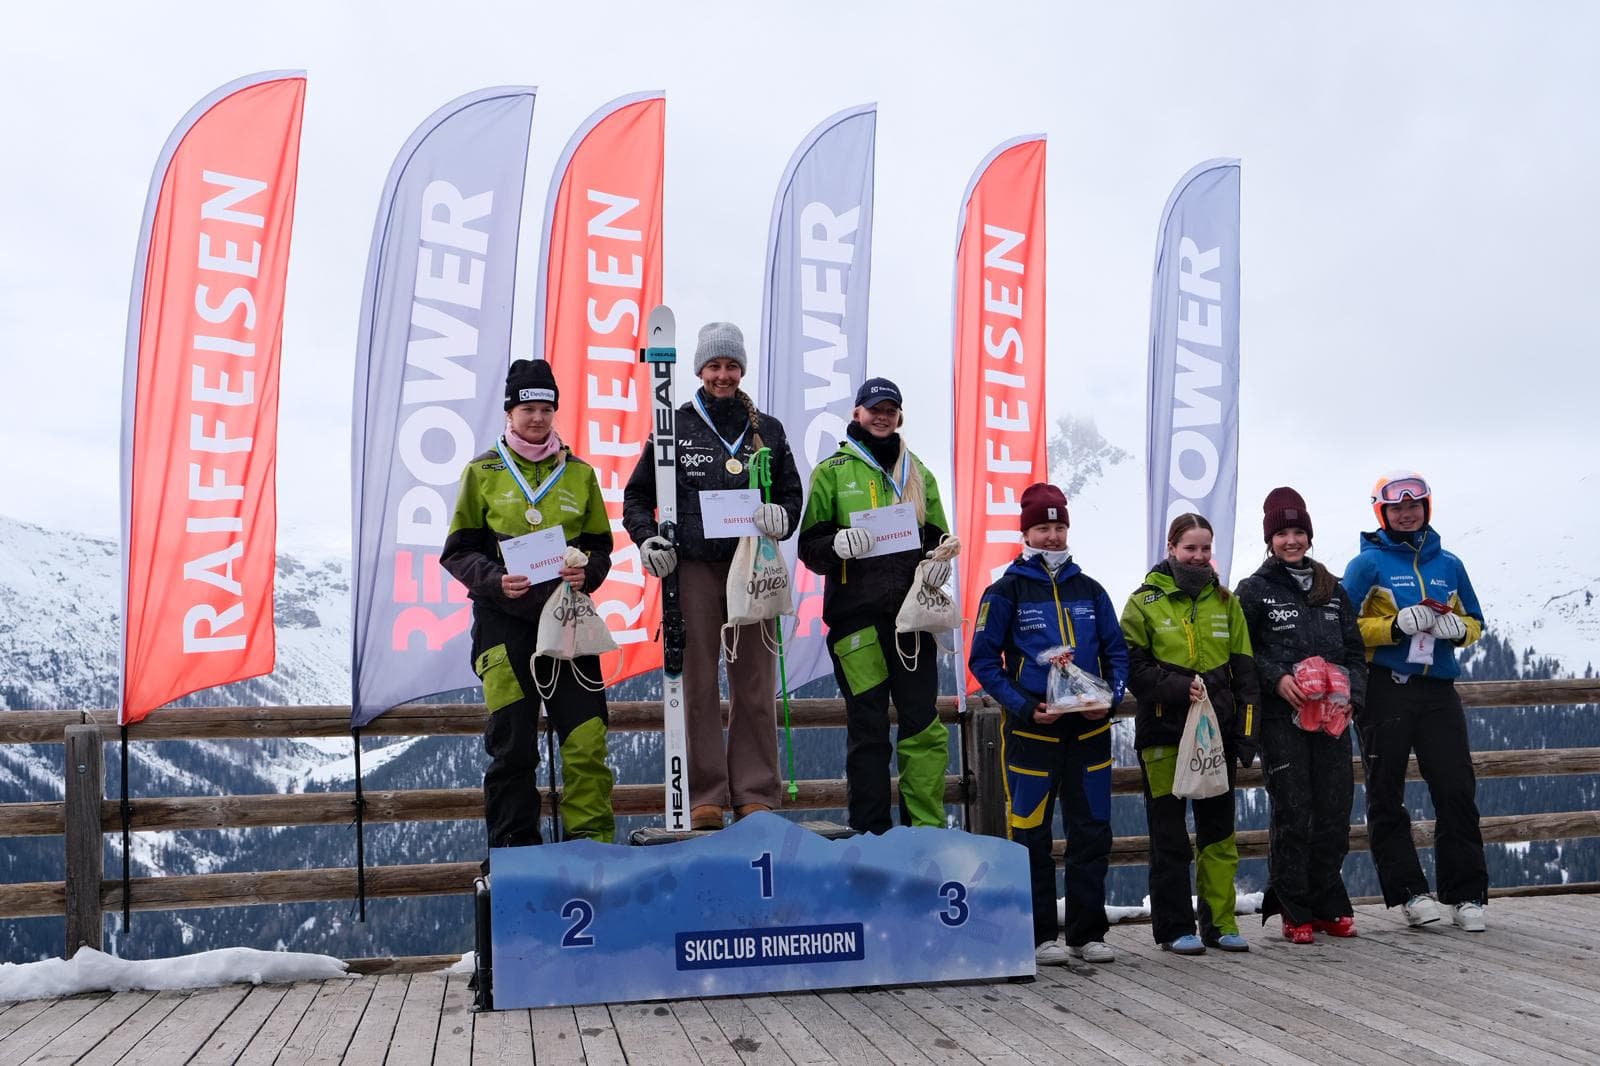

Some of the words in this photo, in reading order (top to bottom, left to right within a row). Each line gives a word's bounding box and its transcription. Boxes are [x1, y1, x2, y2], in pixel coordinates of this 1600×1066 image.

[182, 169, 269, 655] RAIFFEISEN
[392, 178, 496, 652] REPOWER
[983, 223, 1033, 587] IFFEISEN
[723, 517, 755, 525] RAIFFEISE
[876, 530, 913, 543] RAIFFEISEN
[530, 555, 565, 570] RAIFFEISEN
[672, 755, 684, 830] HEAD
[751, 852, 774, 898] 1
[561, 898, 595, 948] 2
[938, 880, 970, 927] 3
[685, 937, 756, 962] SKICLUB
[761, 931, 857, 958] RINERHORN
